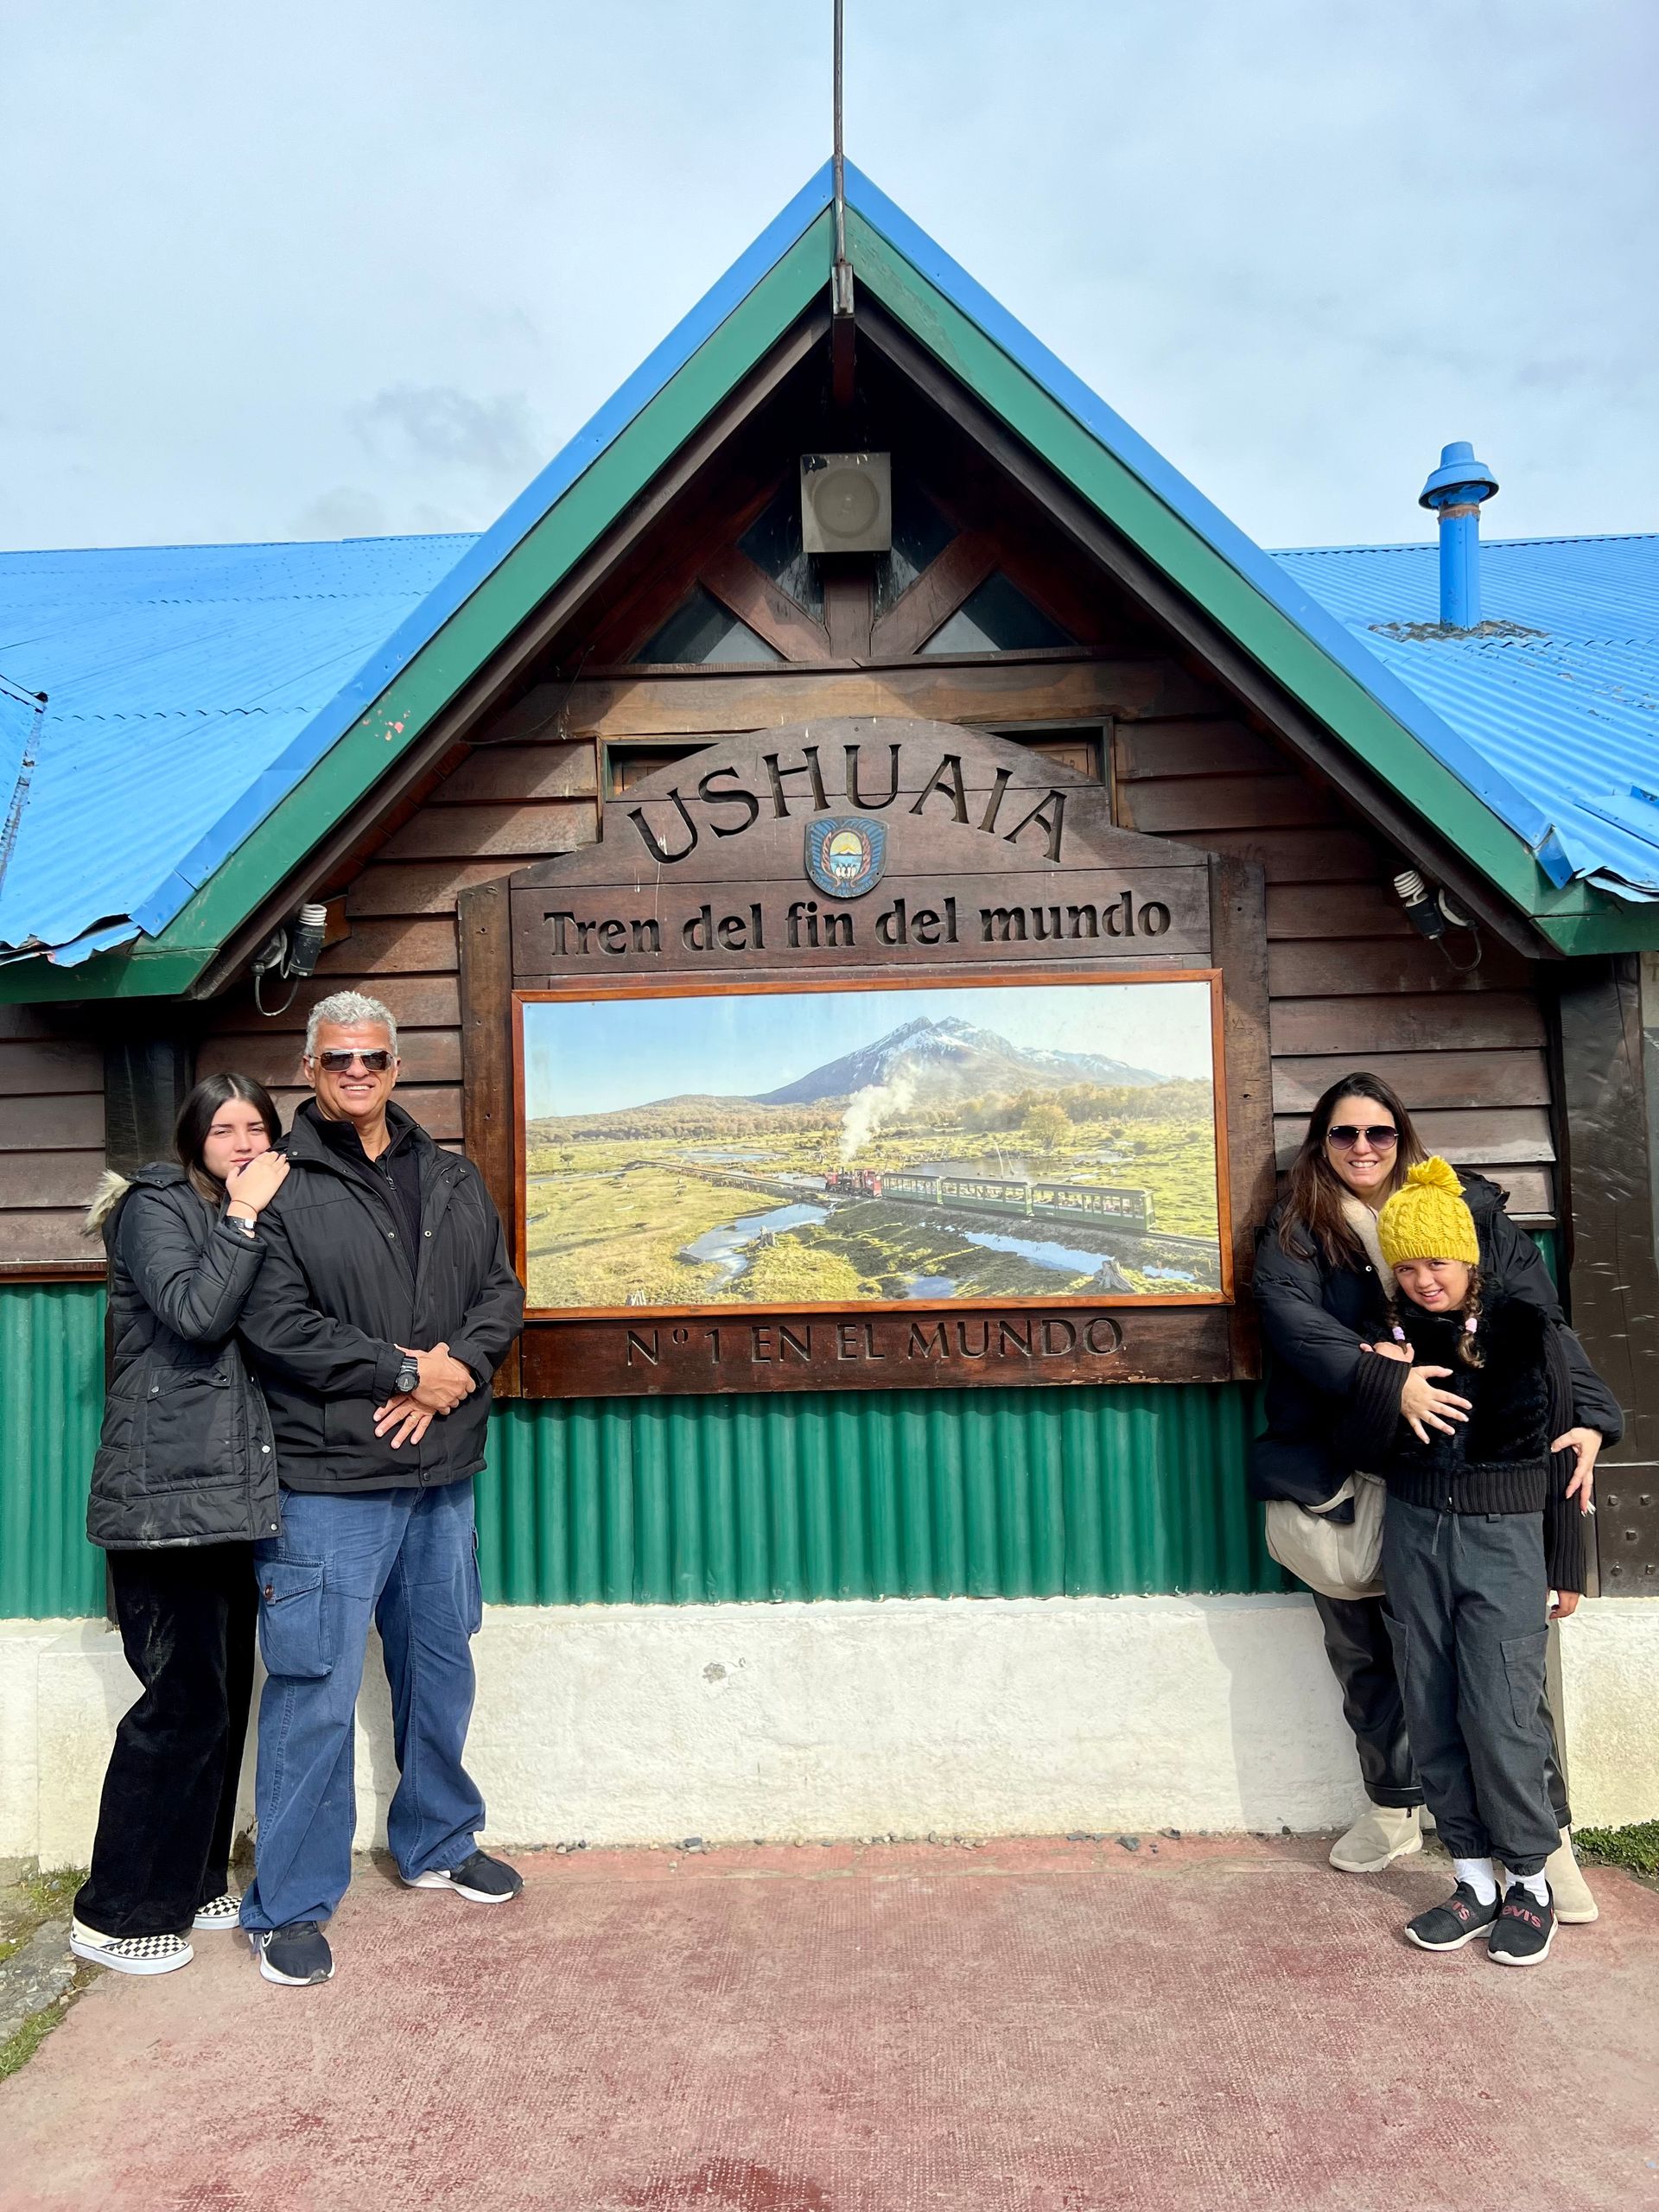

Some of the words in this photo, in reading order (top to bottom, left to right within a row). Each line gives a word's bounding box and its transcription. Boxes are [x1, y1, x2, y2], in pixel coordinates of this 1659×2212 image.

[627, 744, 1067, 863] USHUAIA
[543, 911, 662, 956] Tren
[683, 902, 766, 952] del
[785, 900, 855, 948] fin
[874, 896, 958, 945] del
[979, 890, 1172, 942] mundo
[704, 1326, 721, 1364] 1
[751, 1325, 812, 1363] EN
[837, 1323, 886, 1360] EL
[907, 1318, 1123, 1359] MUNDO
